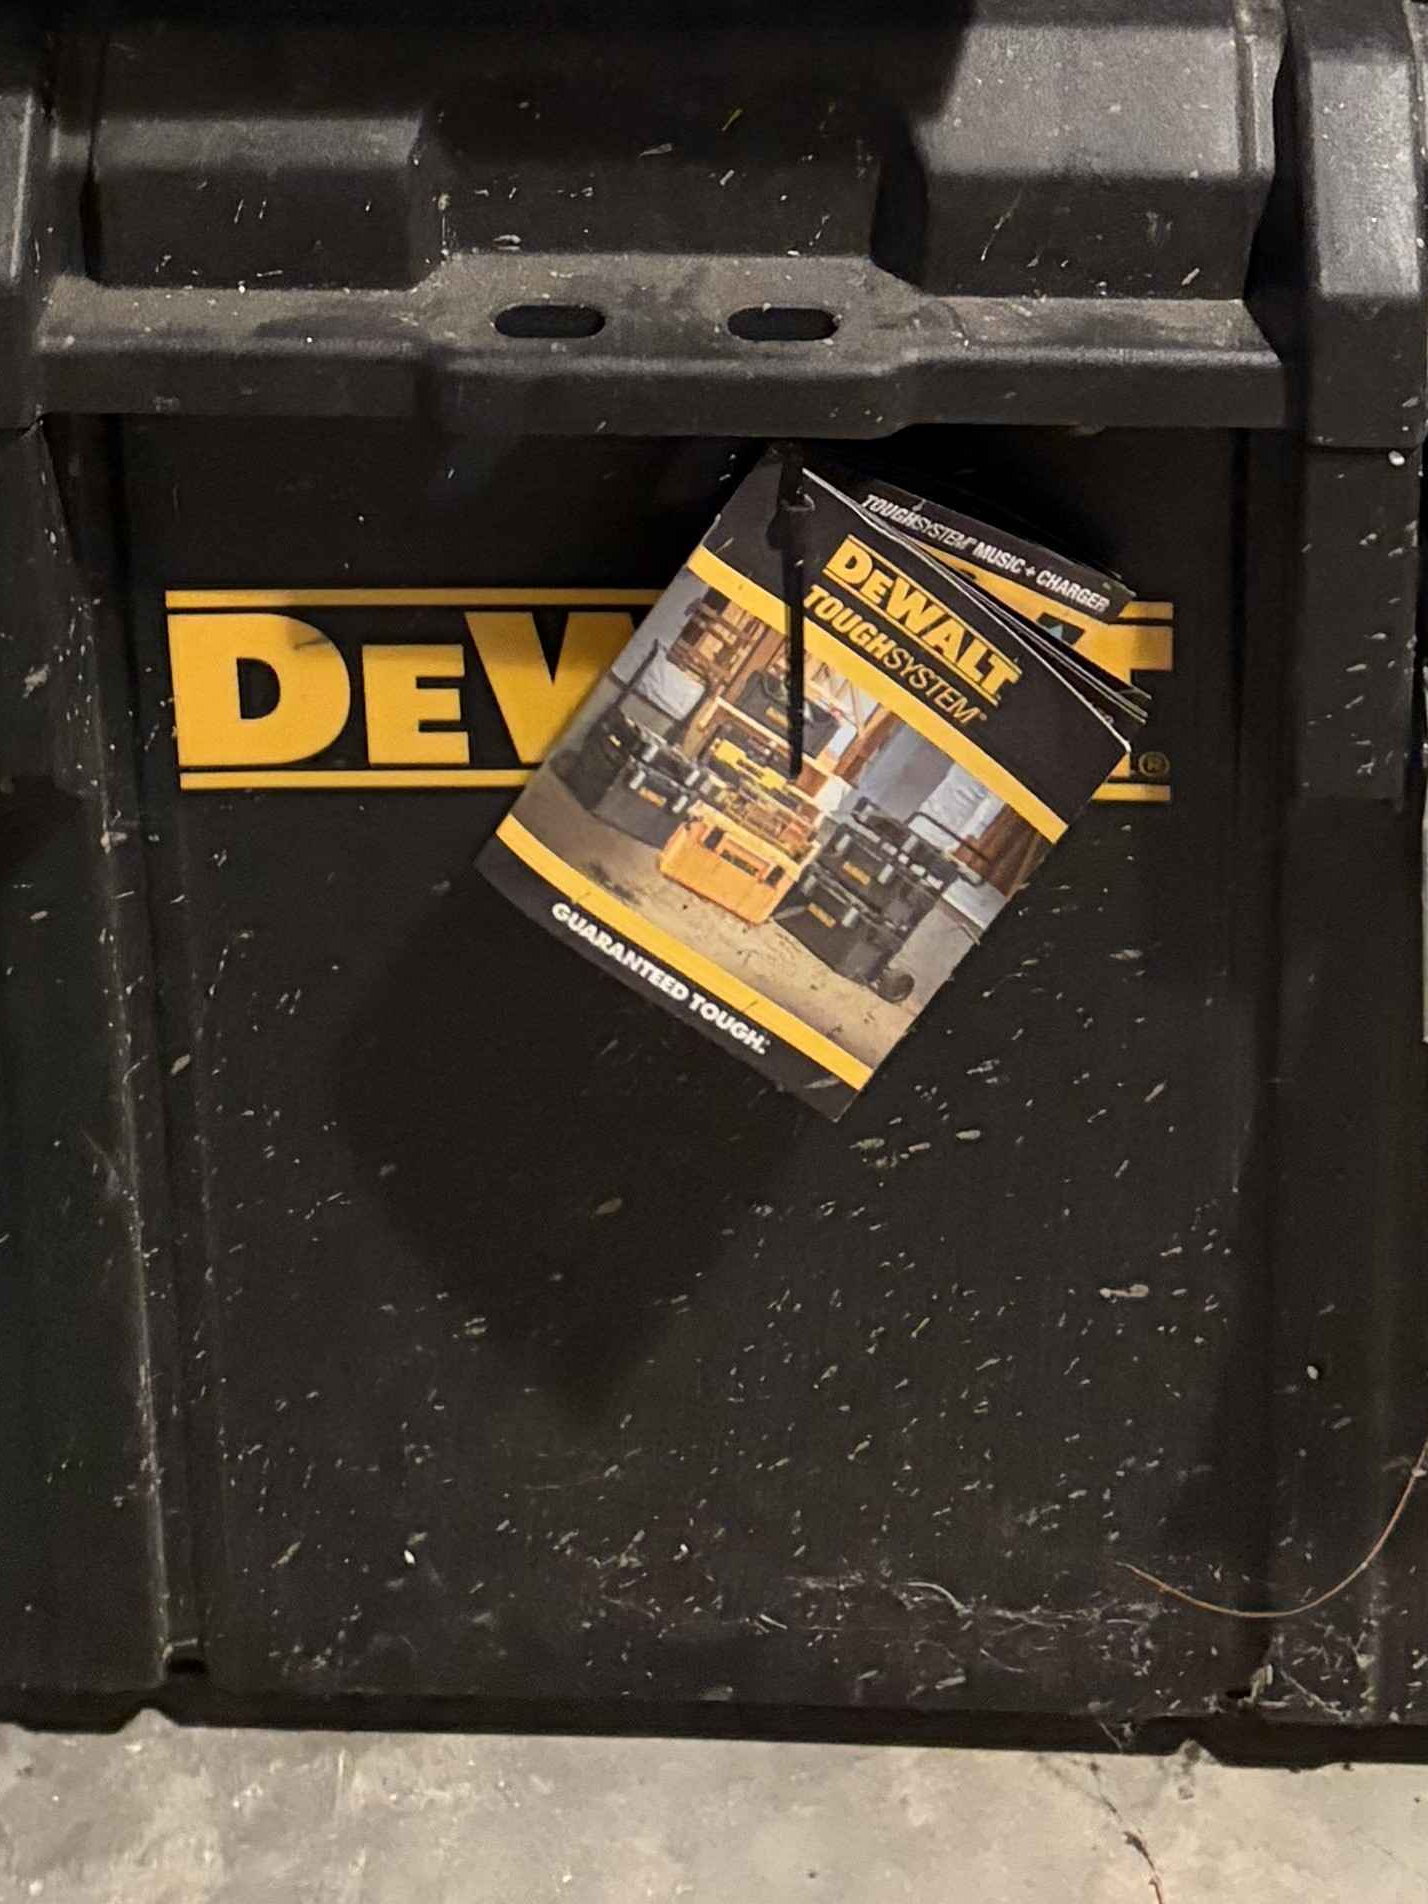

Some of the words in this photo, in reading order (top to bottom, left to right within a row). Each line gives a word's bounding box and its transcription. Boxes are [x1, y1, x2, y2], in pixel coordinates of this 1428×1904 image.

[824, 538, 1022, 698] DEWALT
[974, 541, 1025, 576] MUSIC
[1035, 570, 1110, 614] CHARGER
[551, 901, 690, 1002] GUARANTEED
